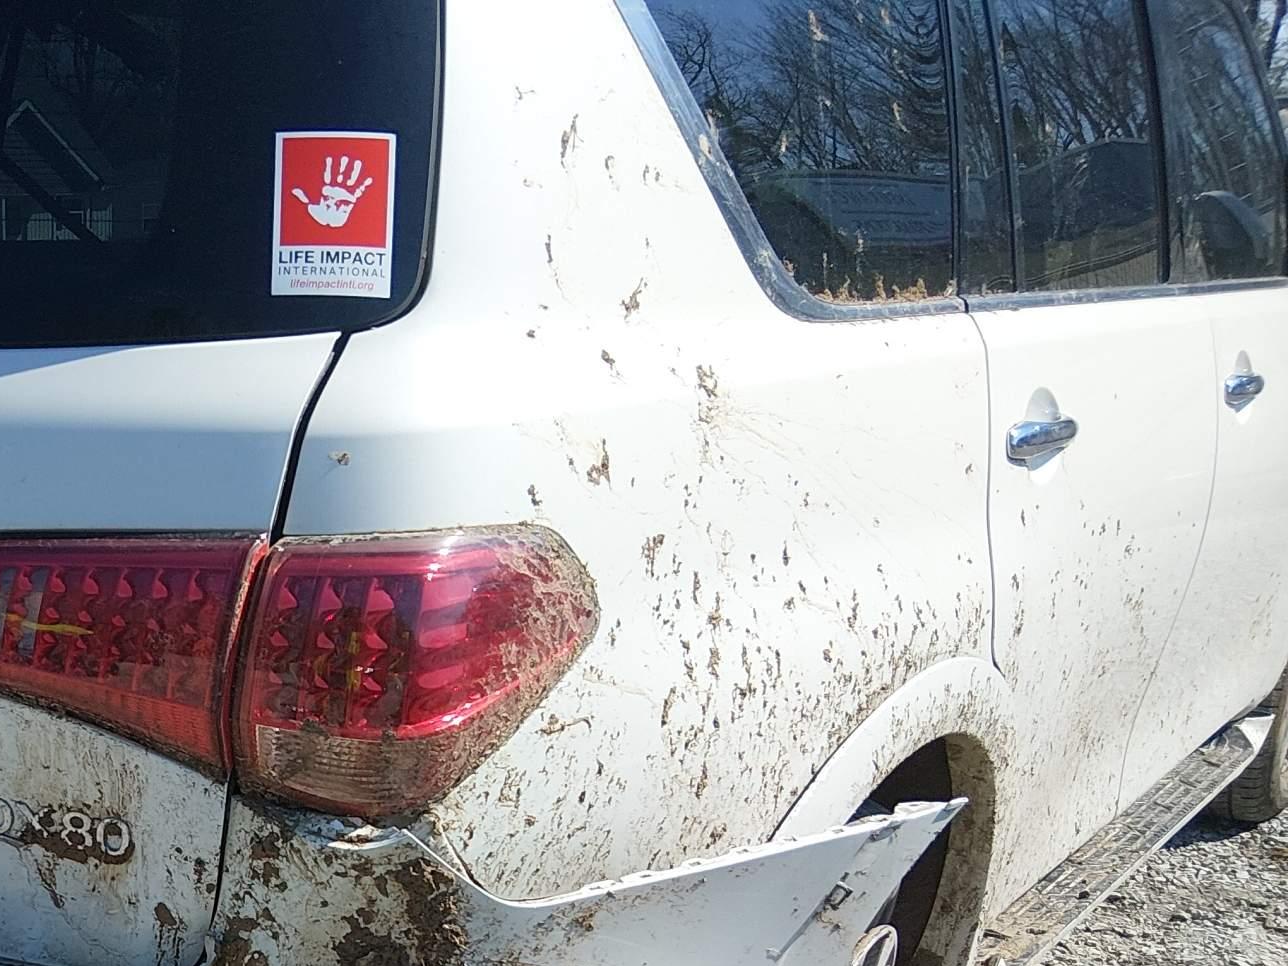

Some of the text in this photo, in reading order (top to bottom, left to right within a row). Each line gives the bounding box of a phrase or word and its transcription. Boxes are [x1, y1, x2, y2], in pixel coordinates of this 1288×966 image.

[279, 250, 386, 266] LIFE IMPACT
[278, 266, 385, 278] INTERNATIONAL
[290, 279, 375, 291] lifeimpactintl.org
